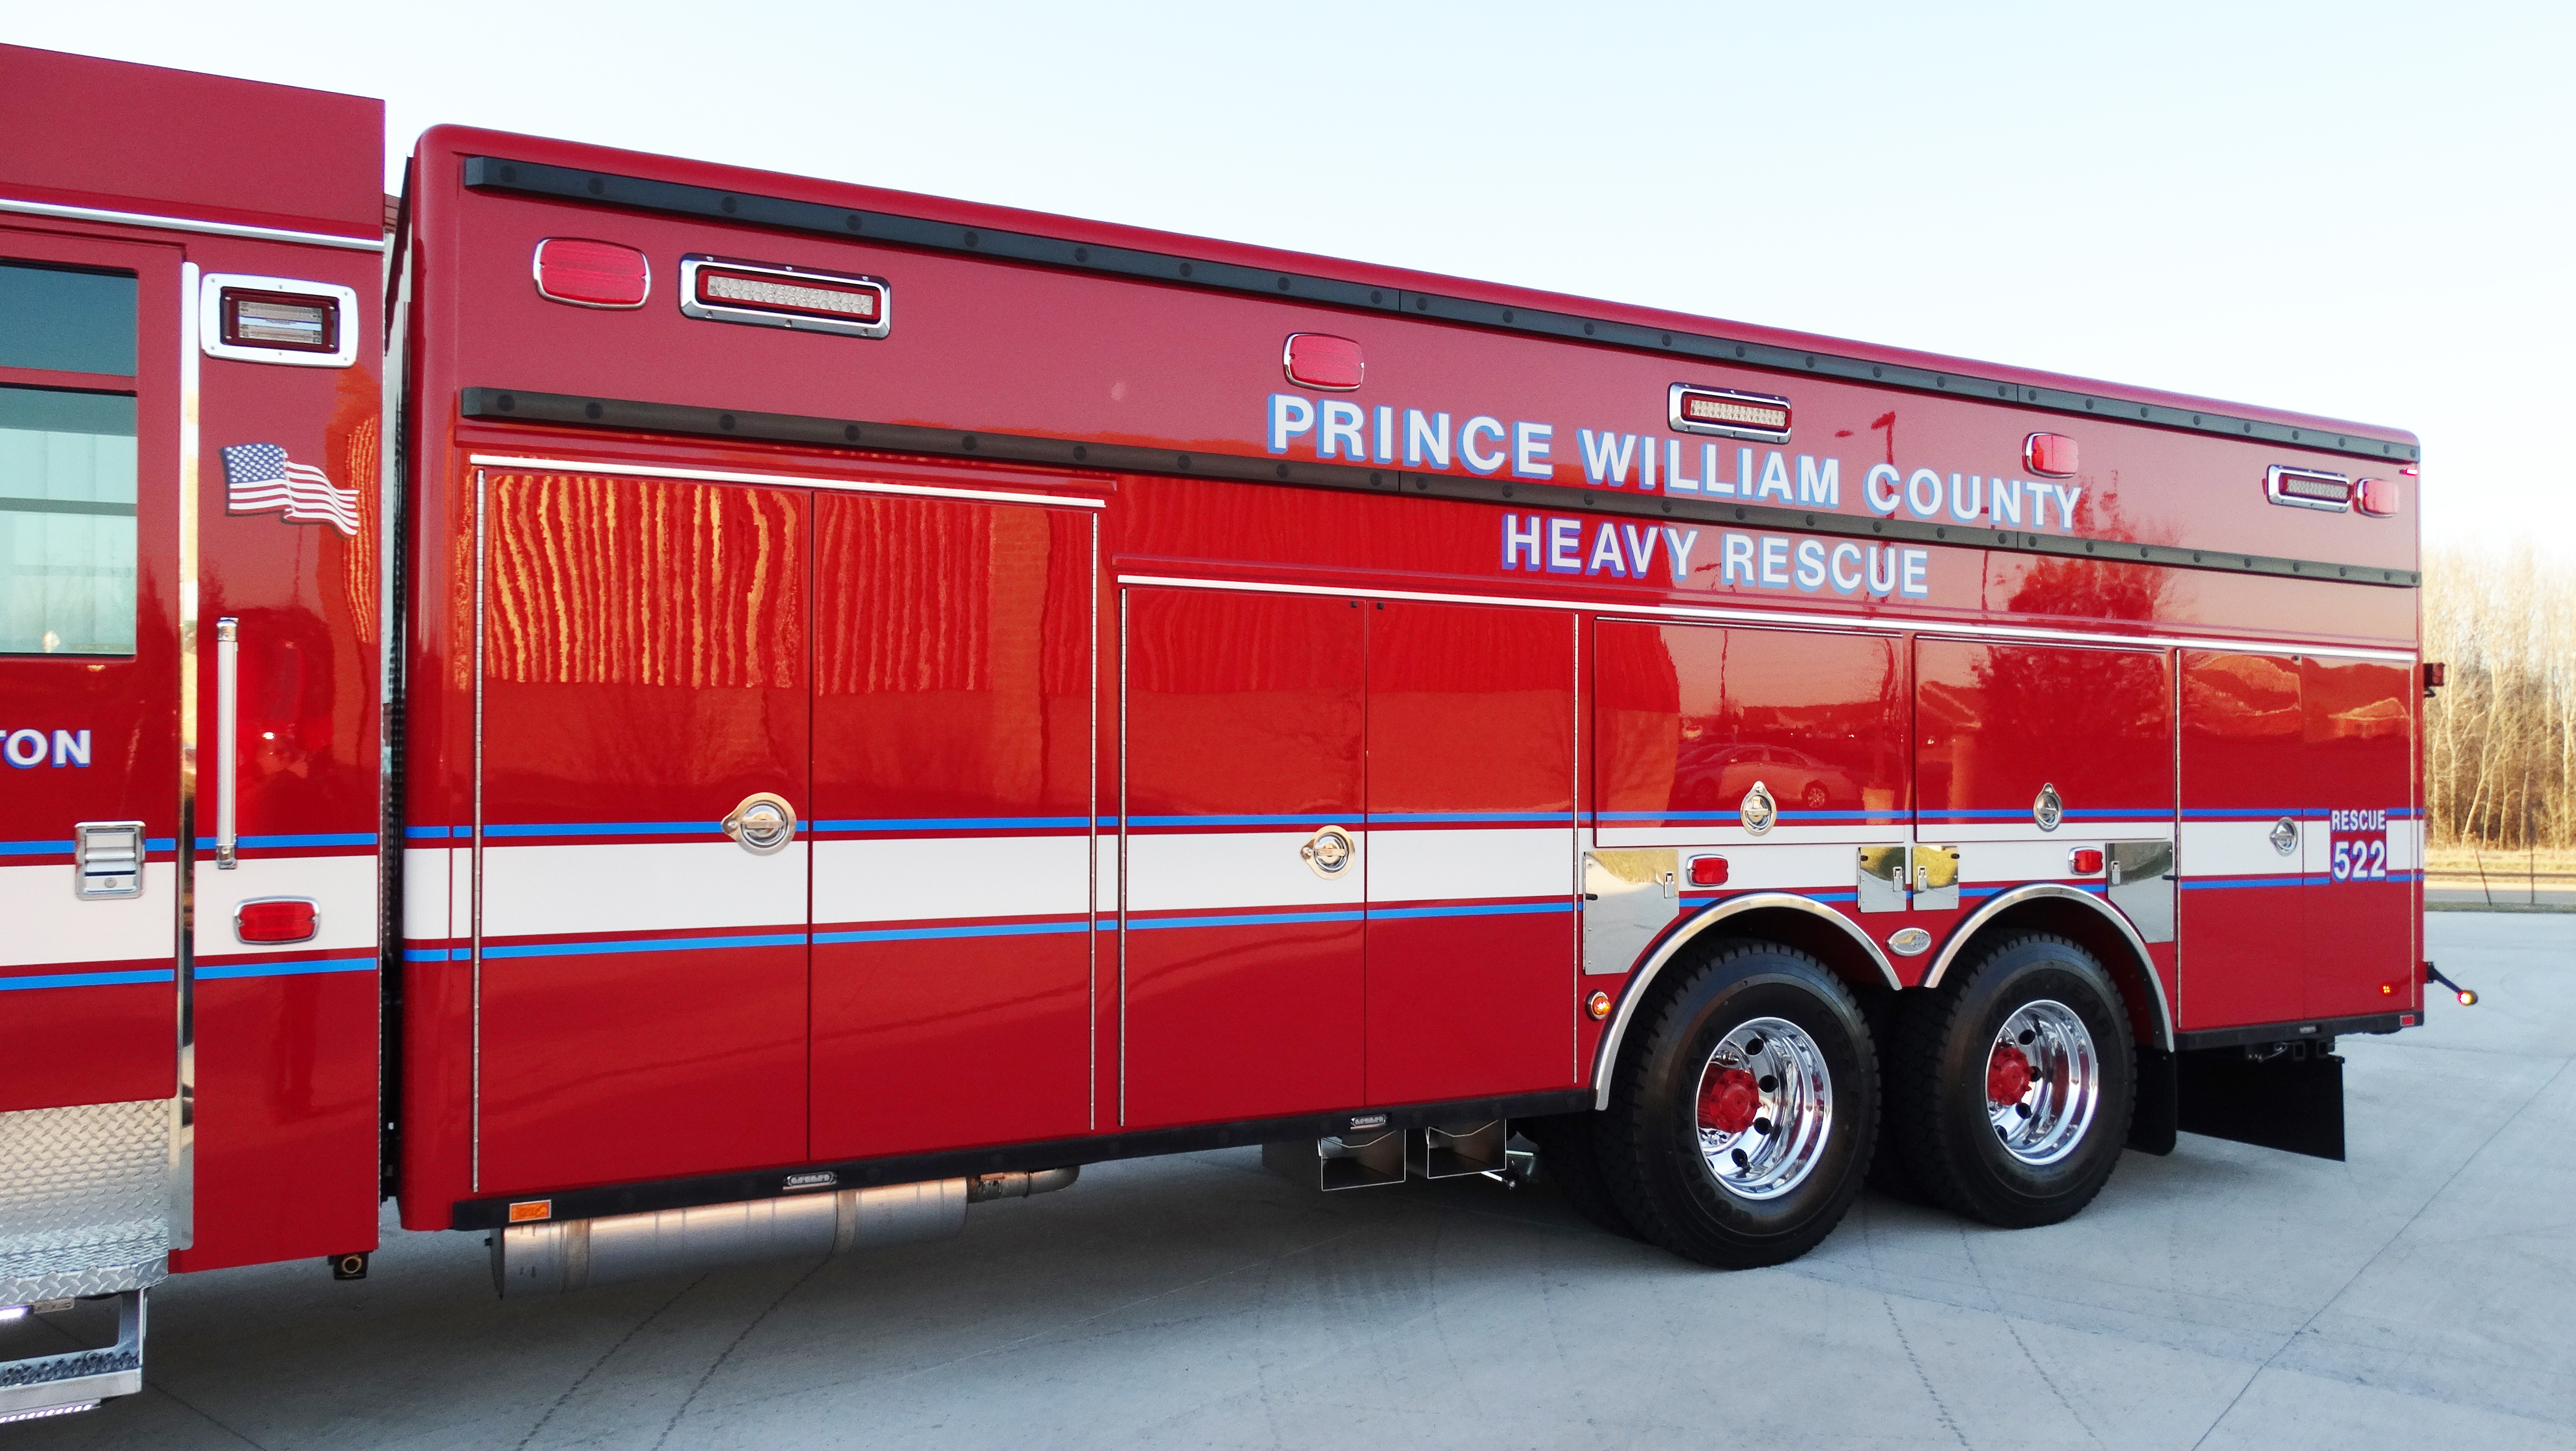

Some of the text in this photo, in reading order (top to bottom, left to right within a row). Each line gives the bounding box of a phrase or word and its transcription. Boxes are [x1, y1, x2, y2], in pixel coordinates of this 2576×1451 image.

[1267, 393, 2083, 533] PRINCE WILLIAM COUNTY
[1502, 513, 1930, 600] HEAVY RESCUE
[0, 729, 91, 769] ON
[2331, 809, 2386, 832] RESCUE
[2333, 840, 2386, 882] 522
